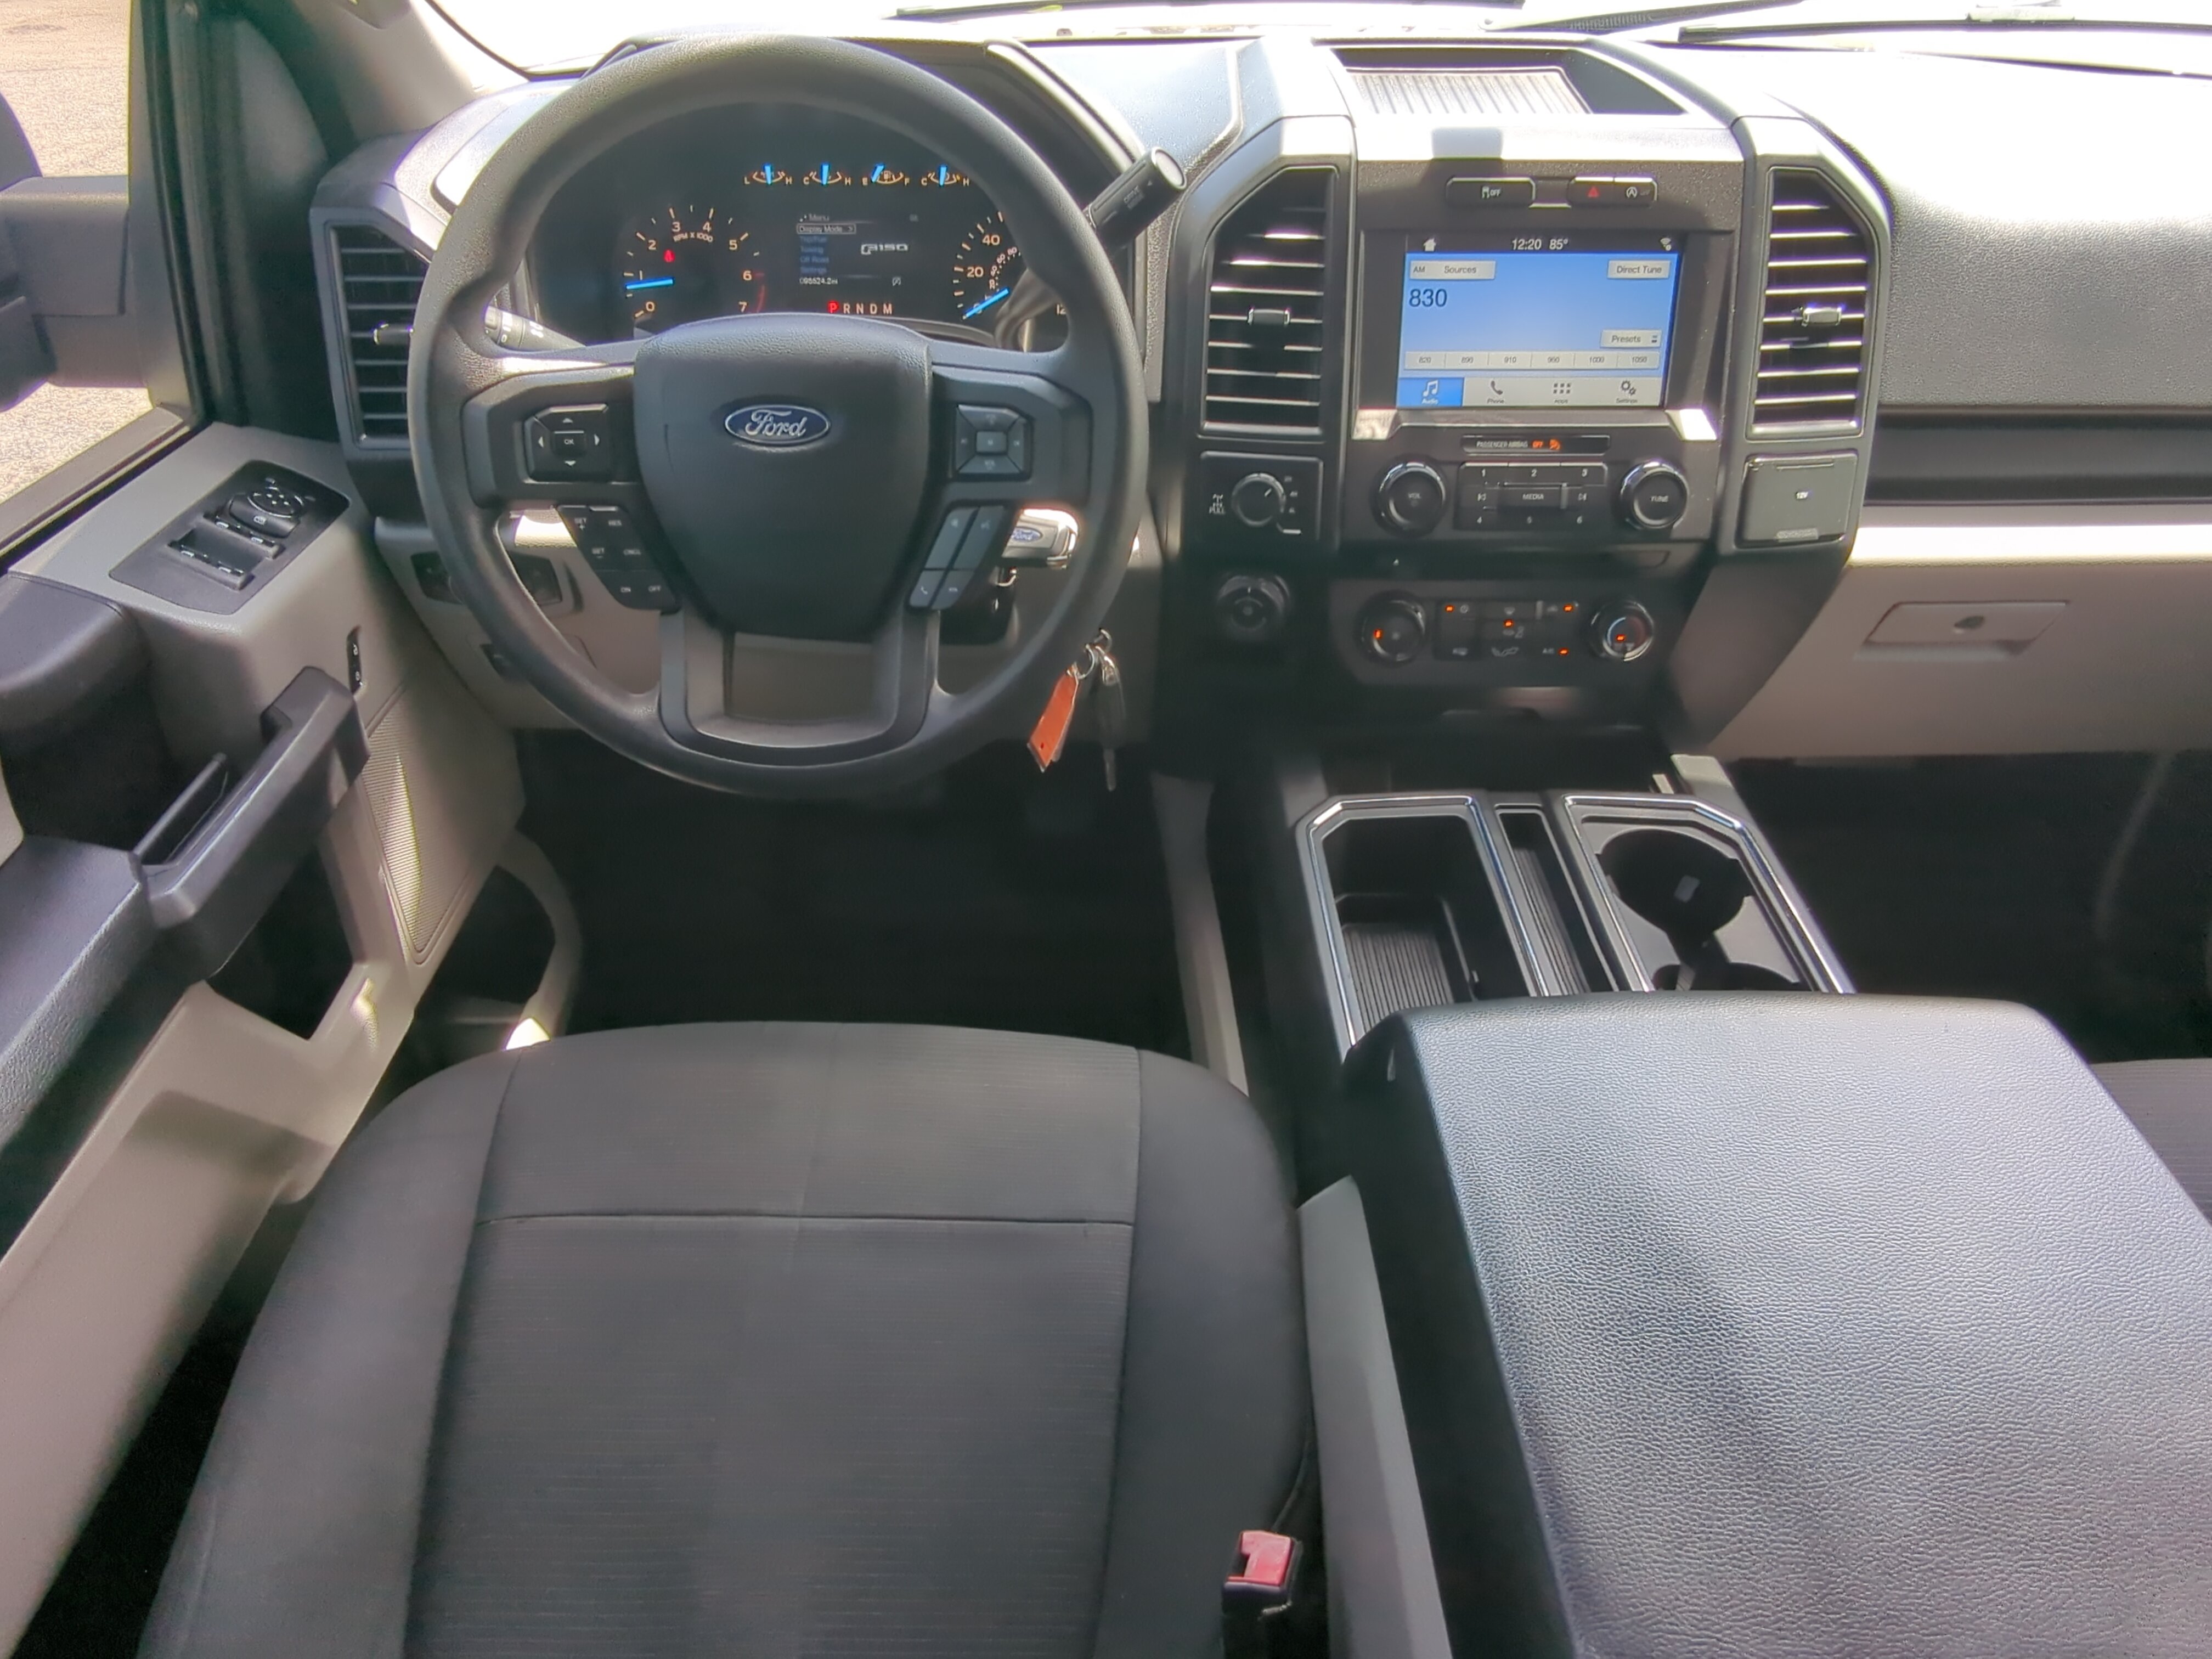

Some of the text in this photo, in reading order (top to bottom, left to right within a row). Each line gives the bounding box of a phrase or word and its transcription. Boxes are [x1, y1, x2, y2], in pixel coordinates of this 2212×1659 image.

[803, 177, 851, 185] C H
[672, 222, 681, 232] 3
[703, 222, 711, 232] 4
[673, 233, 688, 242] RPM
[697, 233, 713, 242] 1000
[982, 235, 1000, 246] 40
[648, 240, 657, 250] 2
[729, 240, 738, 250] 5
[1512, 239, 1542, 250] 12:20
[967, 267, 984, 278] 20
[1444, 266, 1477, 274] Sources
[1617, 266, 1662, 274] Direct Tune
[743, 270, 752, 281] 6
[1409, 289, 1448, 307] 830
[646, 302, 655, 312] 0
[739, 301, 747, 312] 7
[830, 302, 892, 314] P R N D M
[746, 409, 808, 436] Ford
[1531, 469, 1537, 477] 2
[1582, 469, 1588, 477] 3
